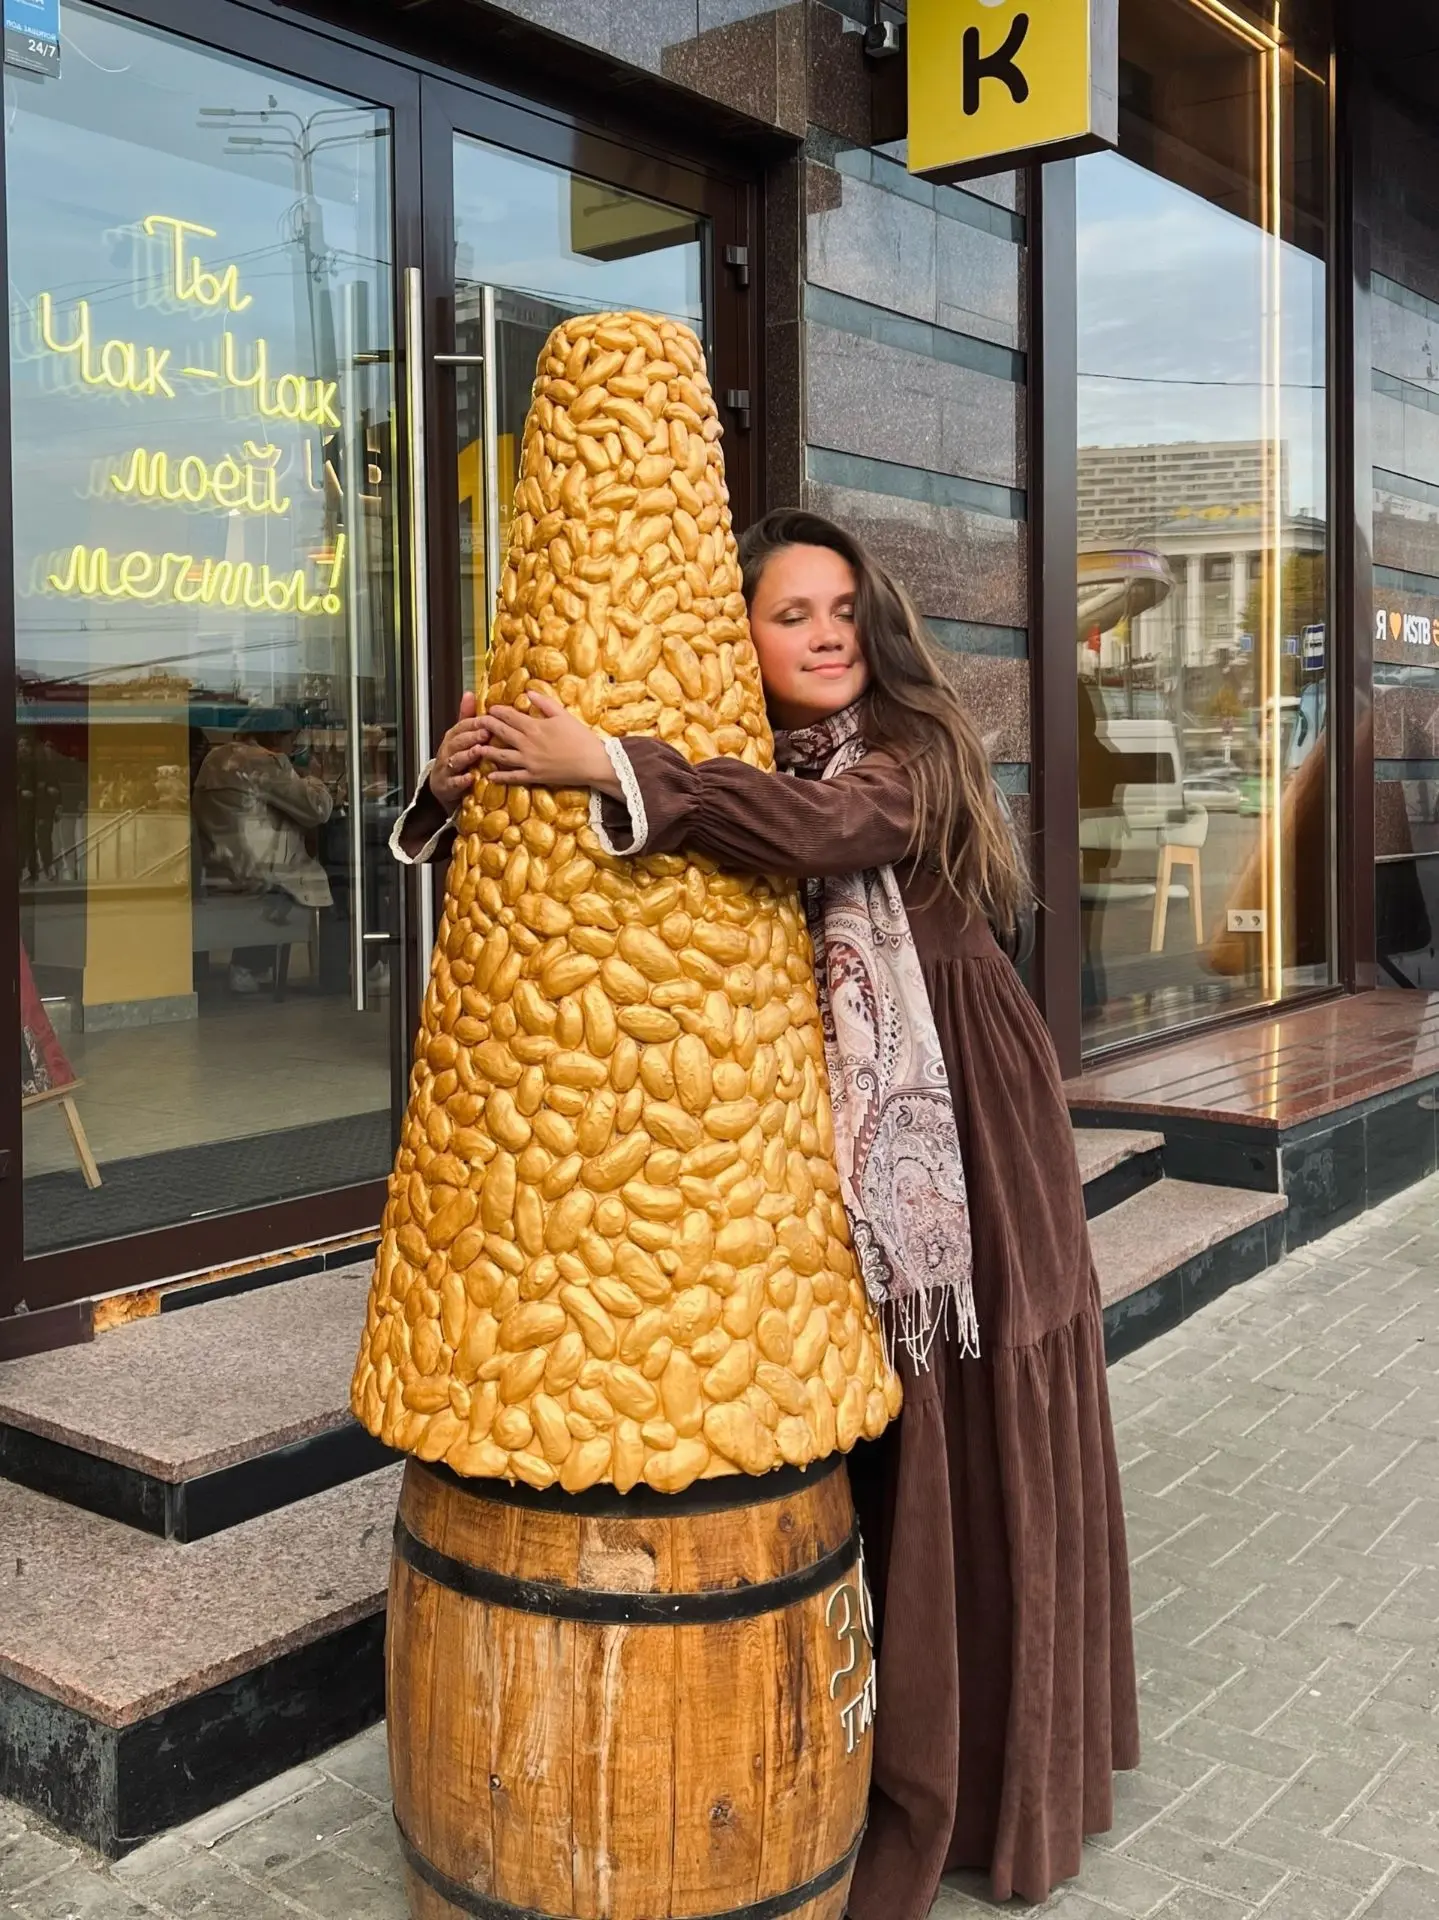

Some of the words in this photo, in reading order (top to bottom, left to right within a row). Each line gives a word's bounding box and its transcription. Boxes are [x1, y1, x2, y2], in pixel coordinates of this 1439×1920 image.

[28, 39, 56, 58] 24/7
[143, 215, 253, 313] Ты
[110, 441, 290, 513] моей
[47, 532, 346, 614] мечты!
[1375, 609, 1387, 641] Я
[1403, 613, 1431, 645] KSTB
